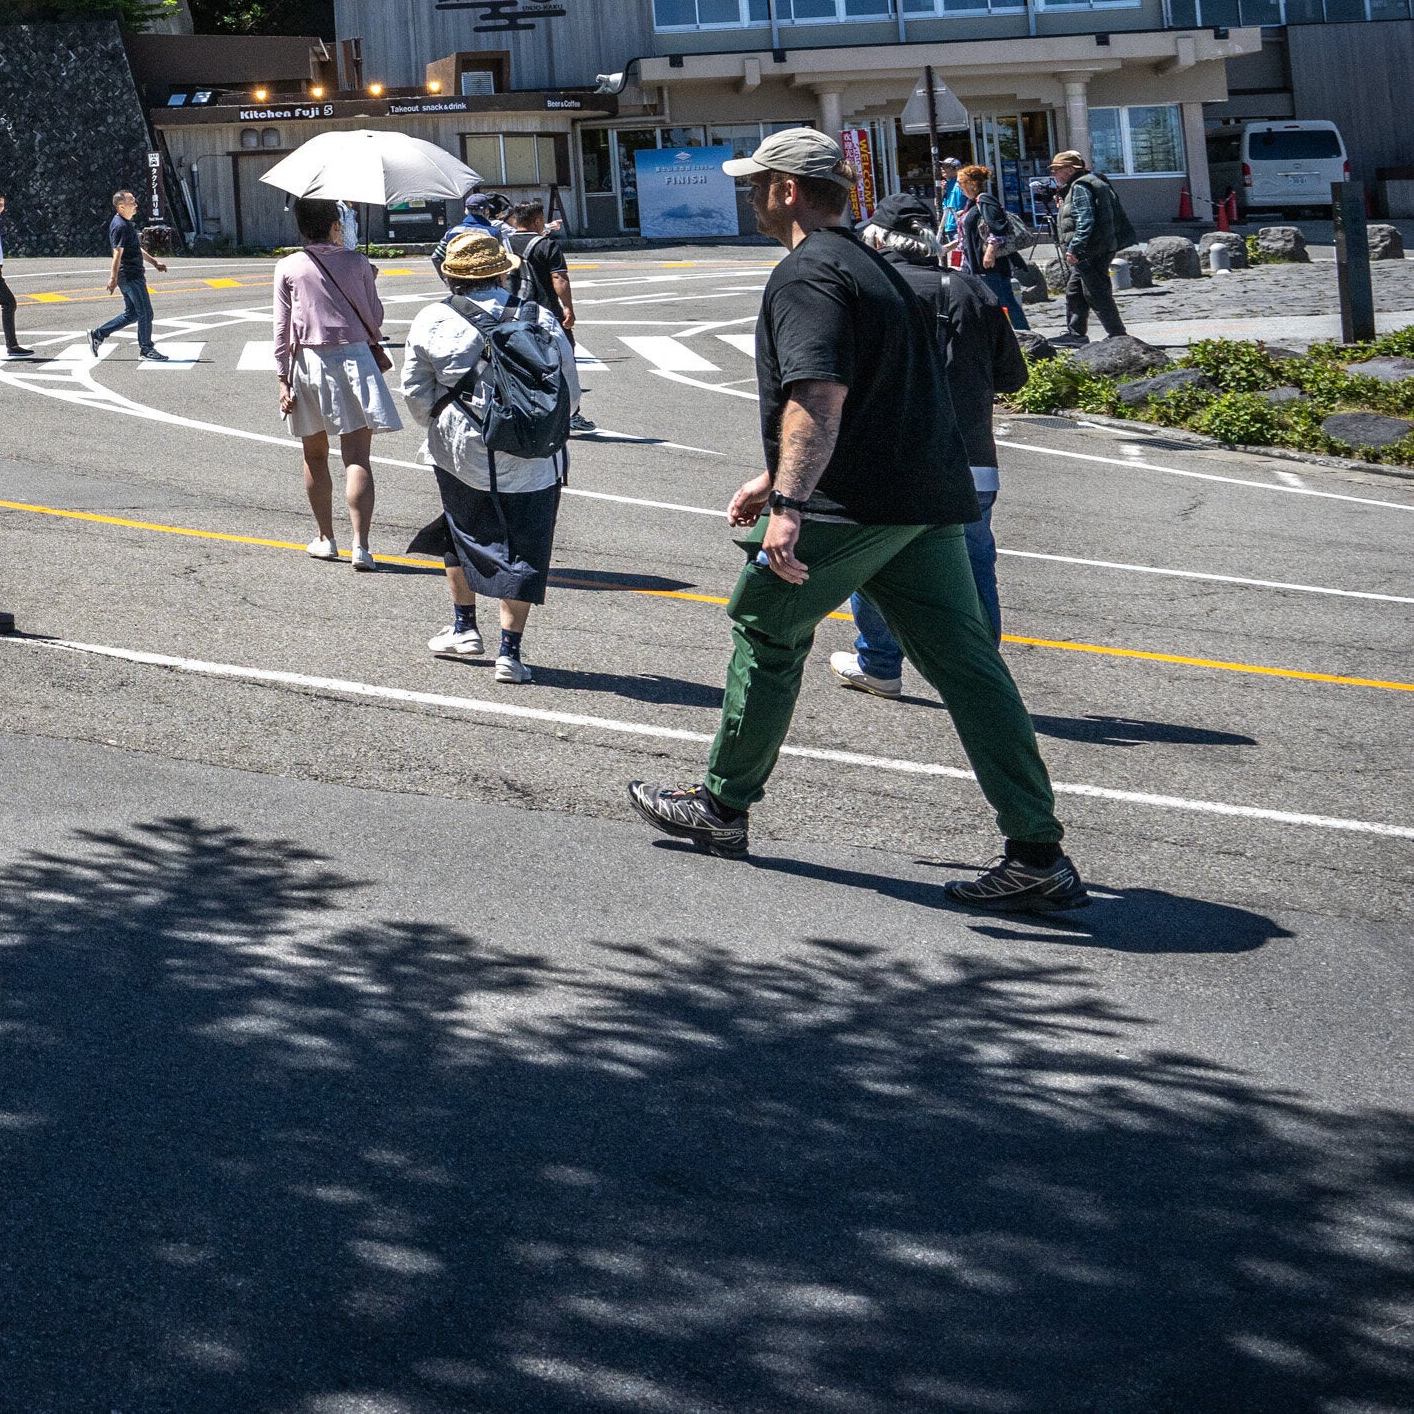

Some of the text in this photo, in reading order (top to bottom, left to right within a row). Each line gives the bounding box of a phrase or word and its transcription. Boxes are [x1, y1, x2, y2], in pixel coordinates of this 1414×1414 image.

[240, 105, 334, 120] Kitchen Fuji 5
[390, 105, 419, 114] Takeout
[664, 175, 708, 186] FINISH
[859, 138, 873, 210] WELCOME
